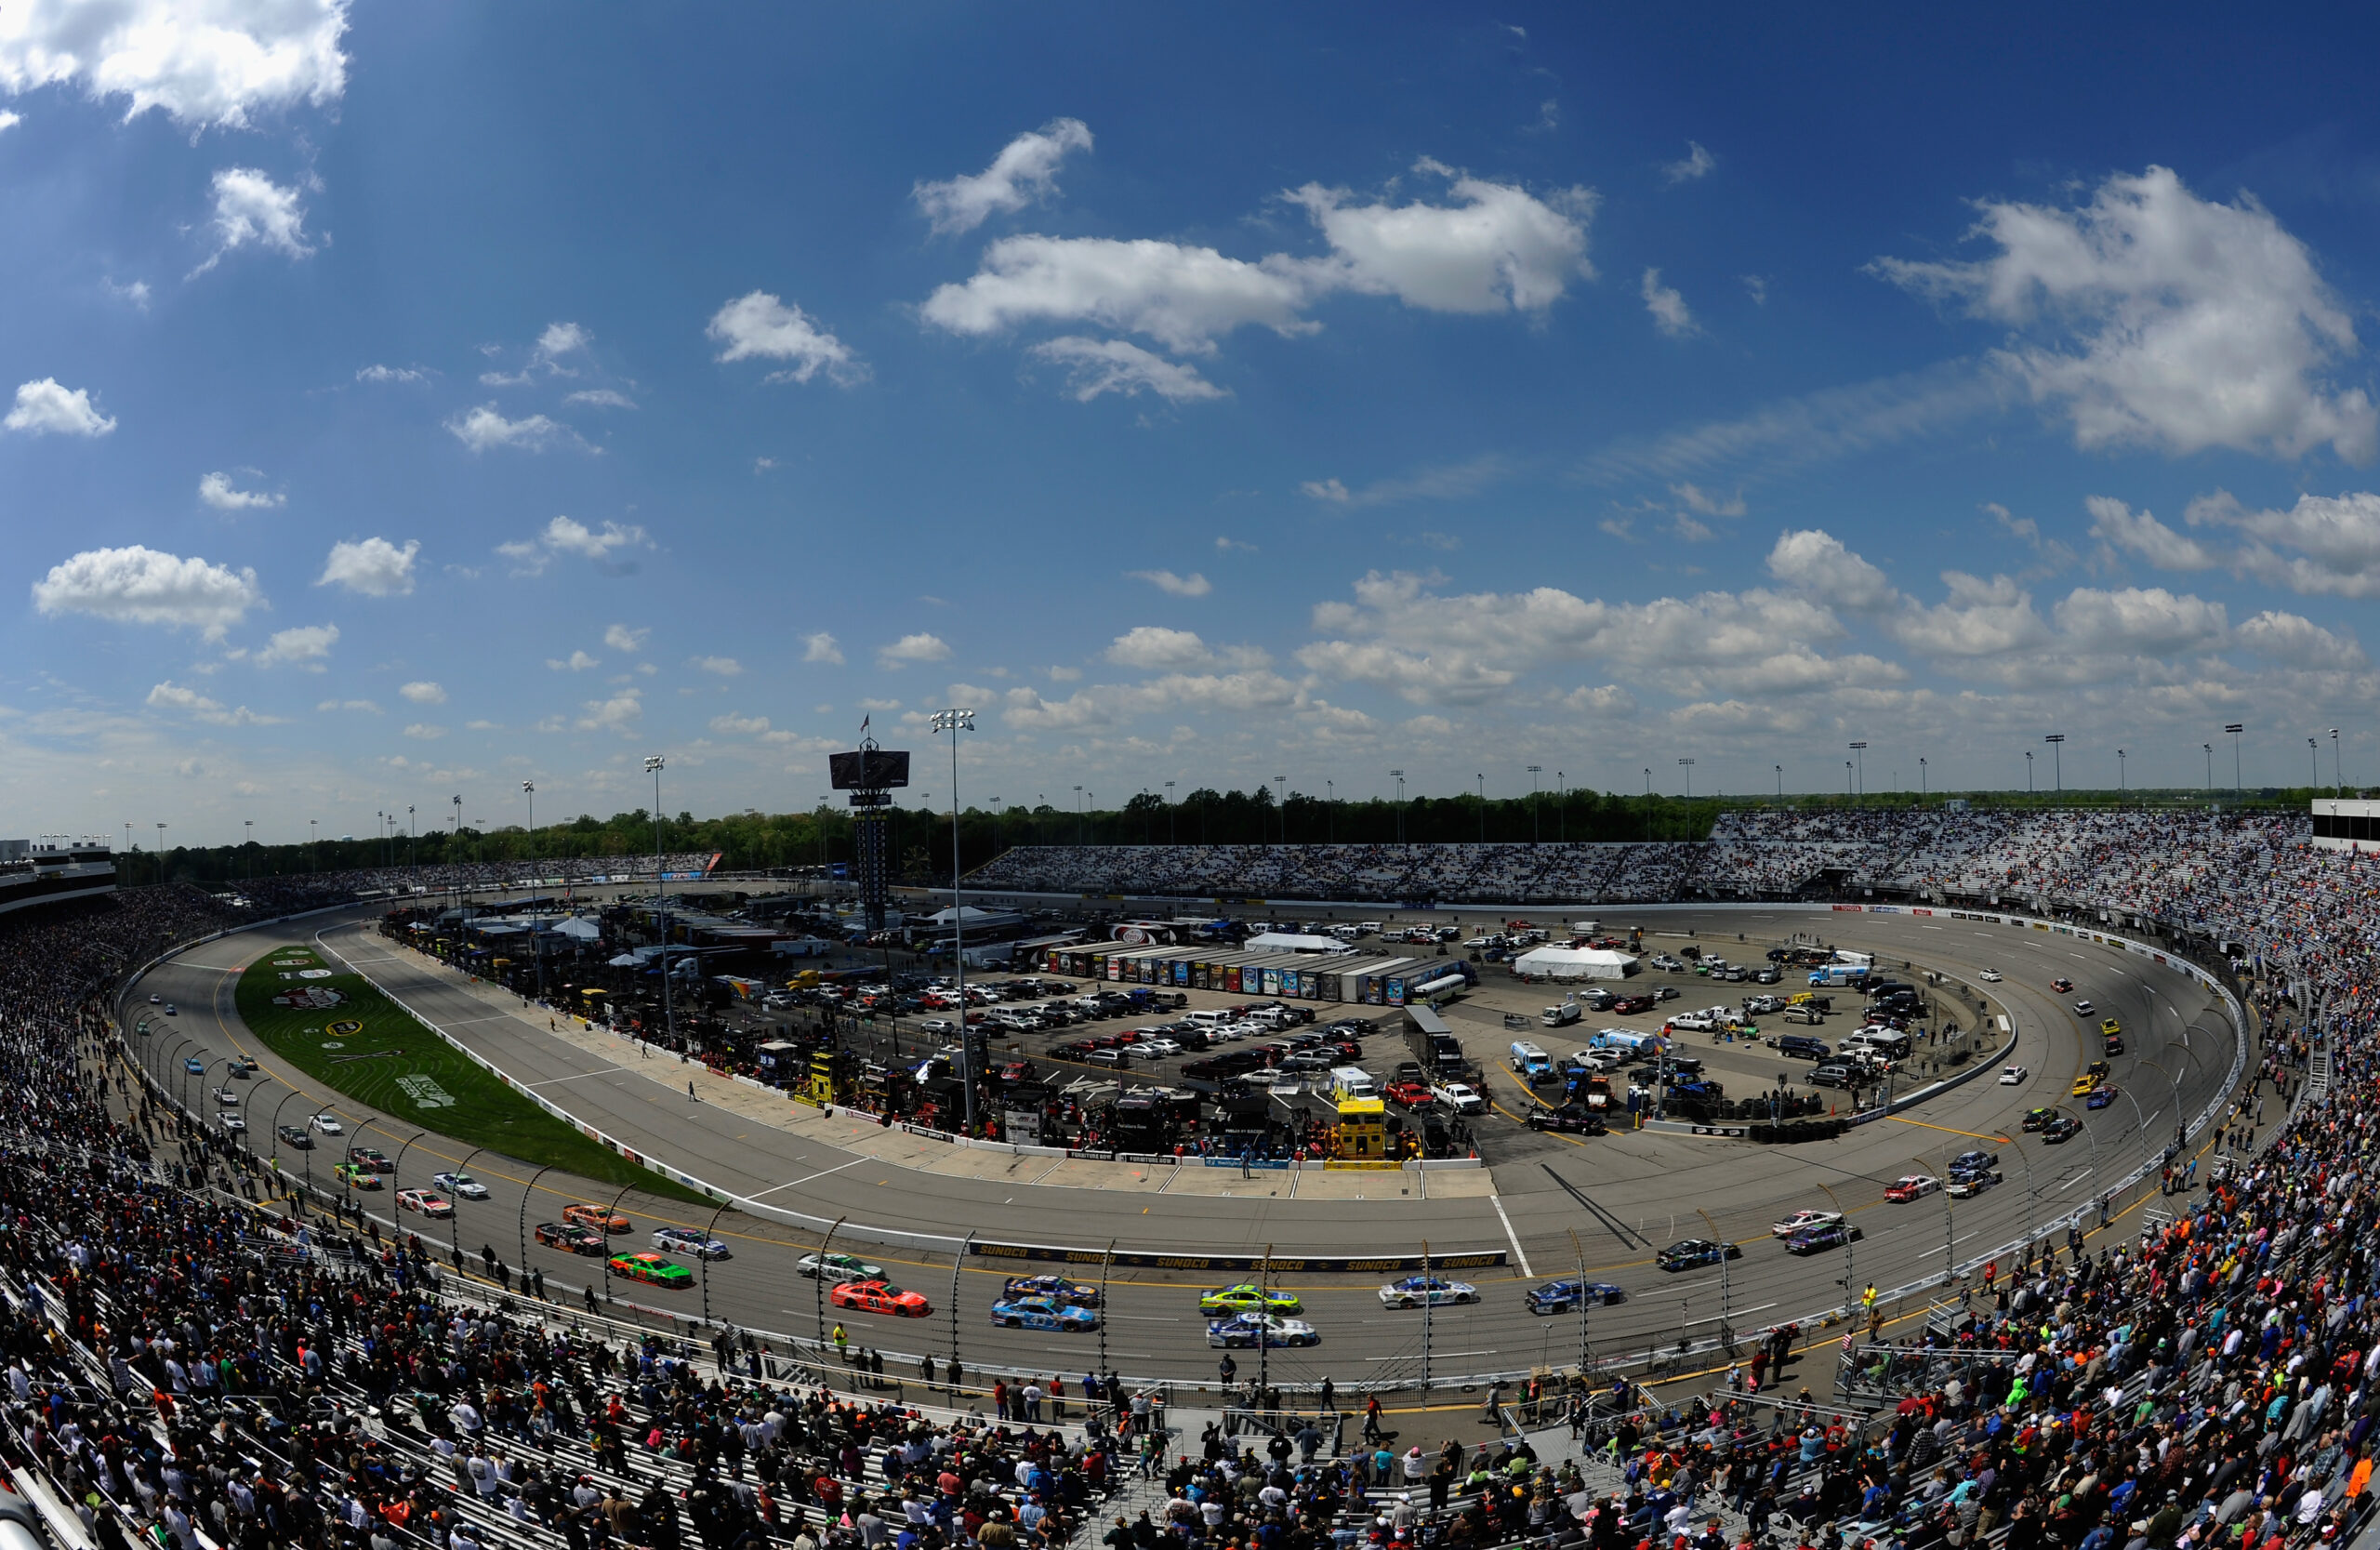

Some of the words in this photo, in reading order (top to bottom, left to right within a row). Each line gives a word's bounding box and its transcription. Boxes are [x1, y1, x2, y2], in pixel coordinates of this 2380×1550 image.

[558, 1238, 567, 1247] 16
[1833, 1233, 1843, 1243] 11
[678, 1243, 686, 1252] 6
[980, 1244, 1027, 1258] SUNOCO
[1157, 1257, 1210, 1268] SUNOCO
[1346, 1260, 1402, 1271] SUNOCO
[1442, 1255, 1497, 1268] SUNOCO
[827, 1268, 841, 1279] 40
[867, 1297, 880, 1309] 51
